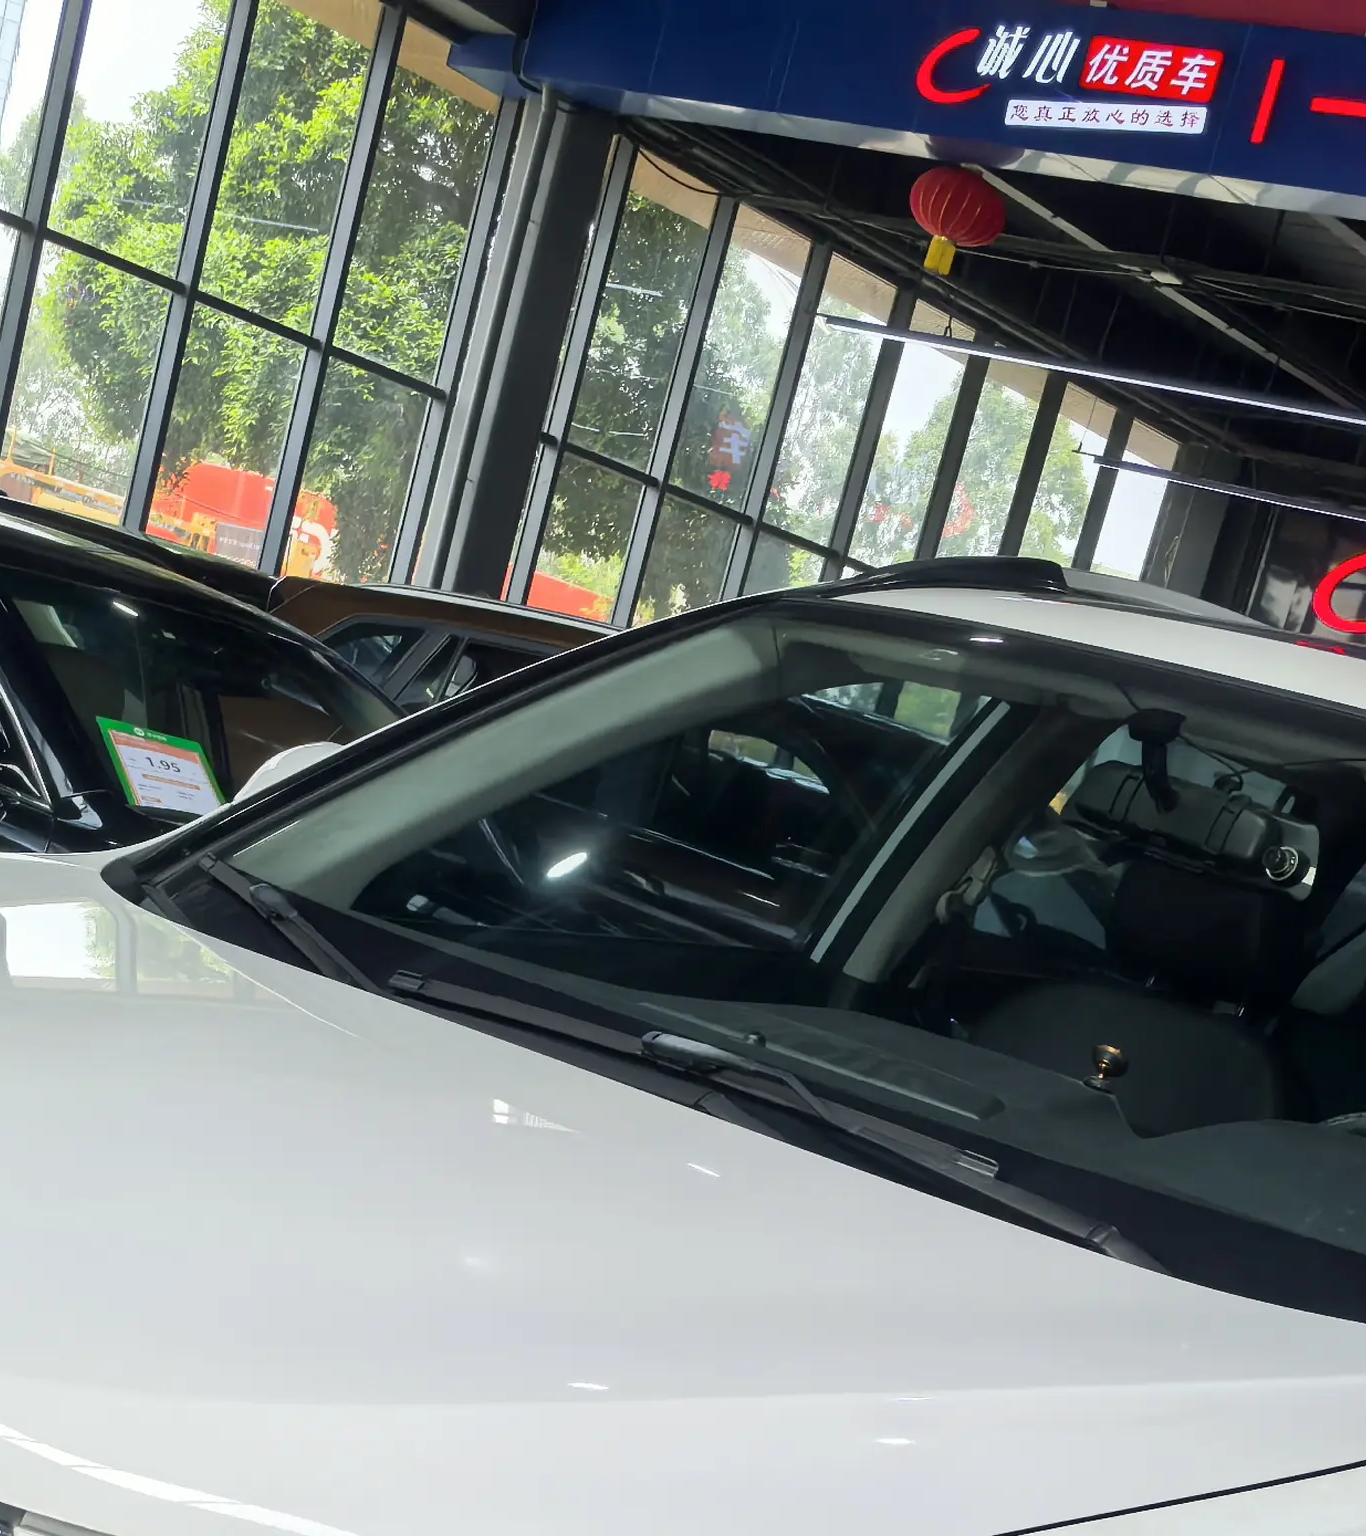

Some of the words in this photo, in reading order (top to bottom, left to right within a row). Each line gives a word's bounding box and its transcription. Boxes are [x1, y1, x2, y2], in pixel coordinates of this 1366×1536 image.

[1009, 104, 1201, 128] 您真正放心的选择
[144, 756, 182, 774] 1.95
